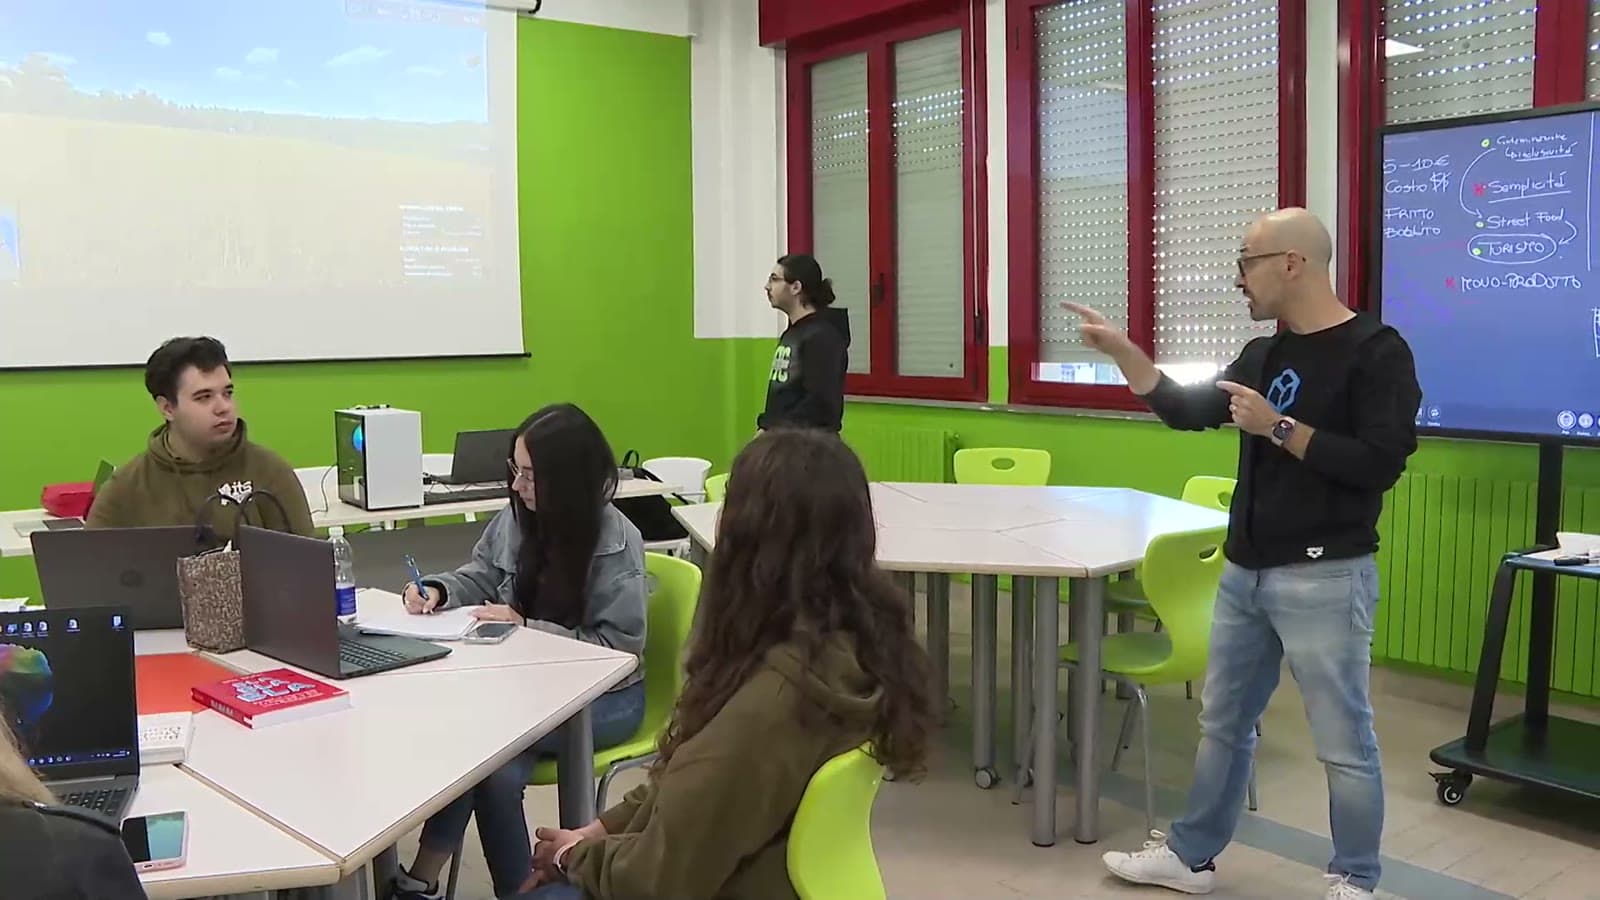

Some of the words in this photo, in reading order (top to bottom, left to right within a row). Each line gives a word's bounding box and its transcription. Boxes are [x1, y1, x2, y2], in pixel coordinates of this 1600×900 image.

[1385, 179, 1428, 193] Costo
[1385, 207, 1434, 220] FRITTO
[1487, 211, 1531, 229] Street
[1535, 208, 1565, 223] Food
[1477, 241, 1545, 256] TURISMO
